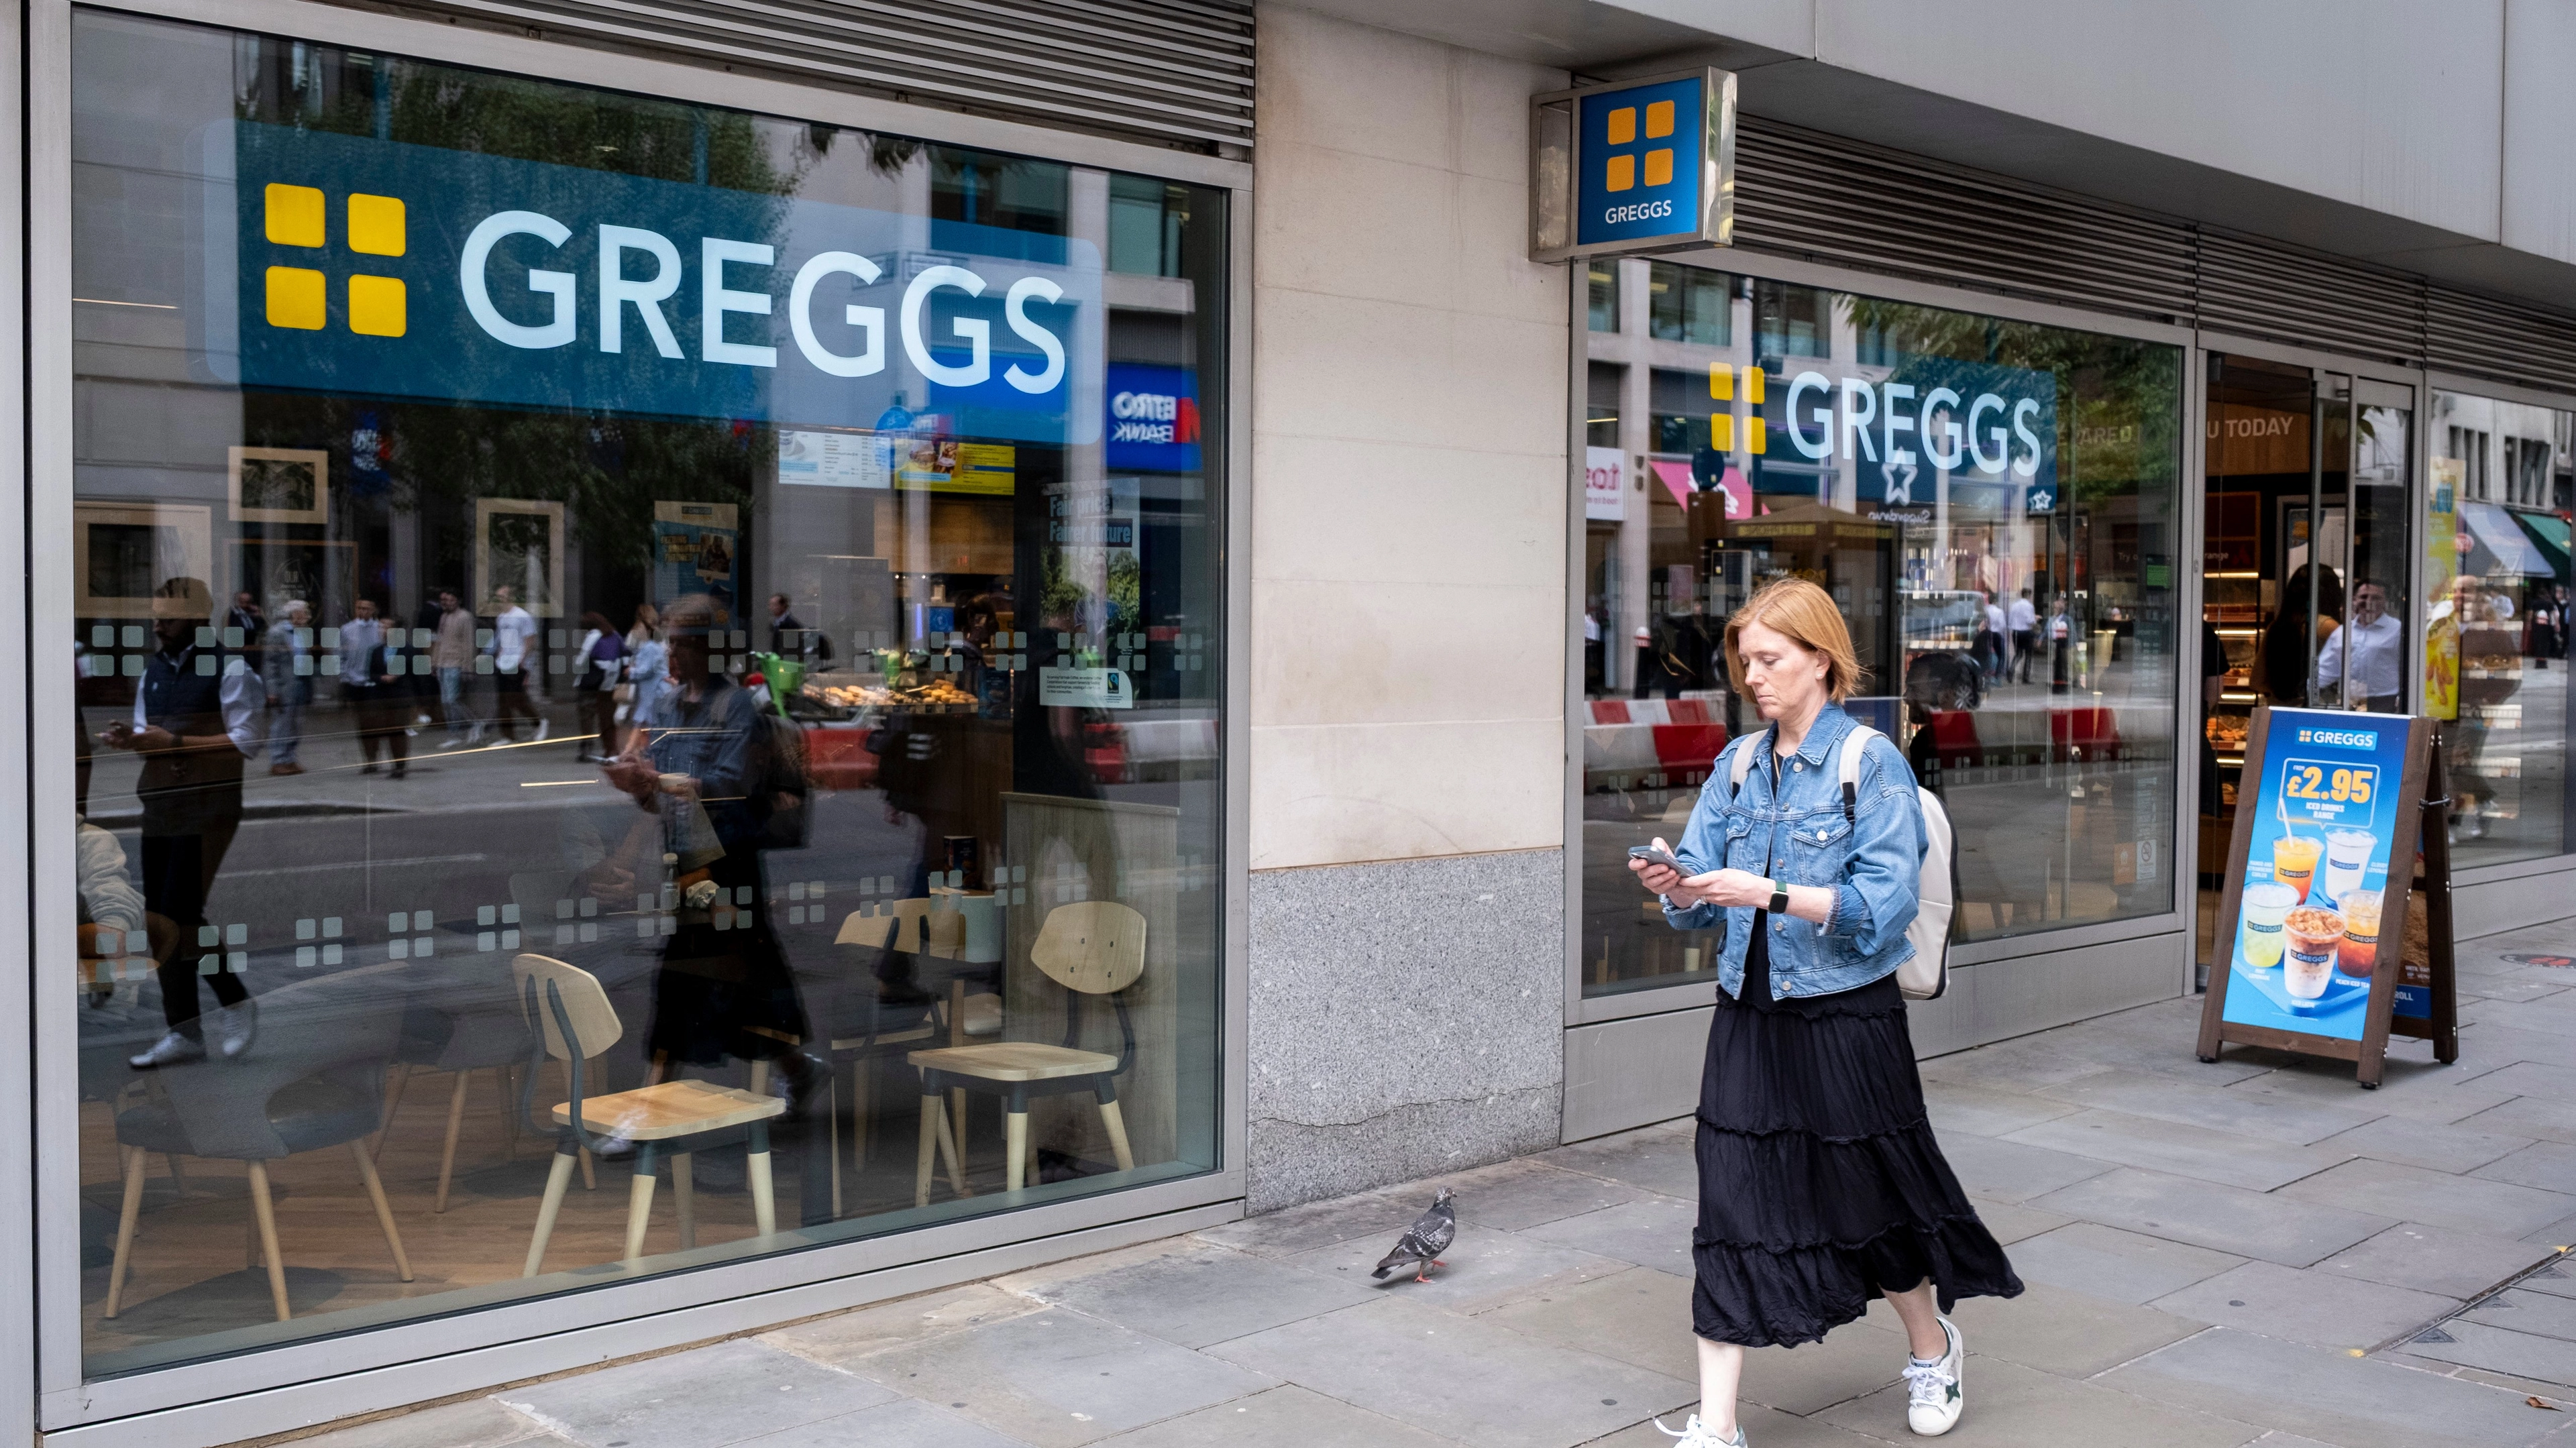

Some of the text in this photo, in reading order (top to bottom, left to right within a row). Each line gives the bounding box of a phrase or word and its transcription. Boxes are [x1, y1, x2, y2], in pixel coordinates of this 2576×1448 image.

[1605, 200, 1672, 224] GREGGS
[460, 209, 1066, 394] GREGGS
[1786, 371, 2041, 477] GREGGS
[2224, 416, 2294, 438] TODAY
[1050, 491, 1110, 520] Fair price
[1050, 520, 1132, 543] Fairer future
[2313, 731, 2374, 747] GREGGS
[2287, 766, 2373, 803] £2.95
[2254, 924, 2281, 933] GREGGS
[2297, 952, 2328, 962] GREGGS
